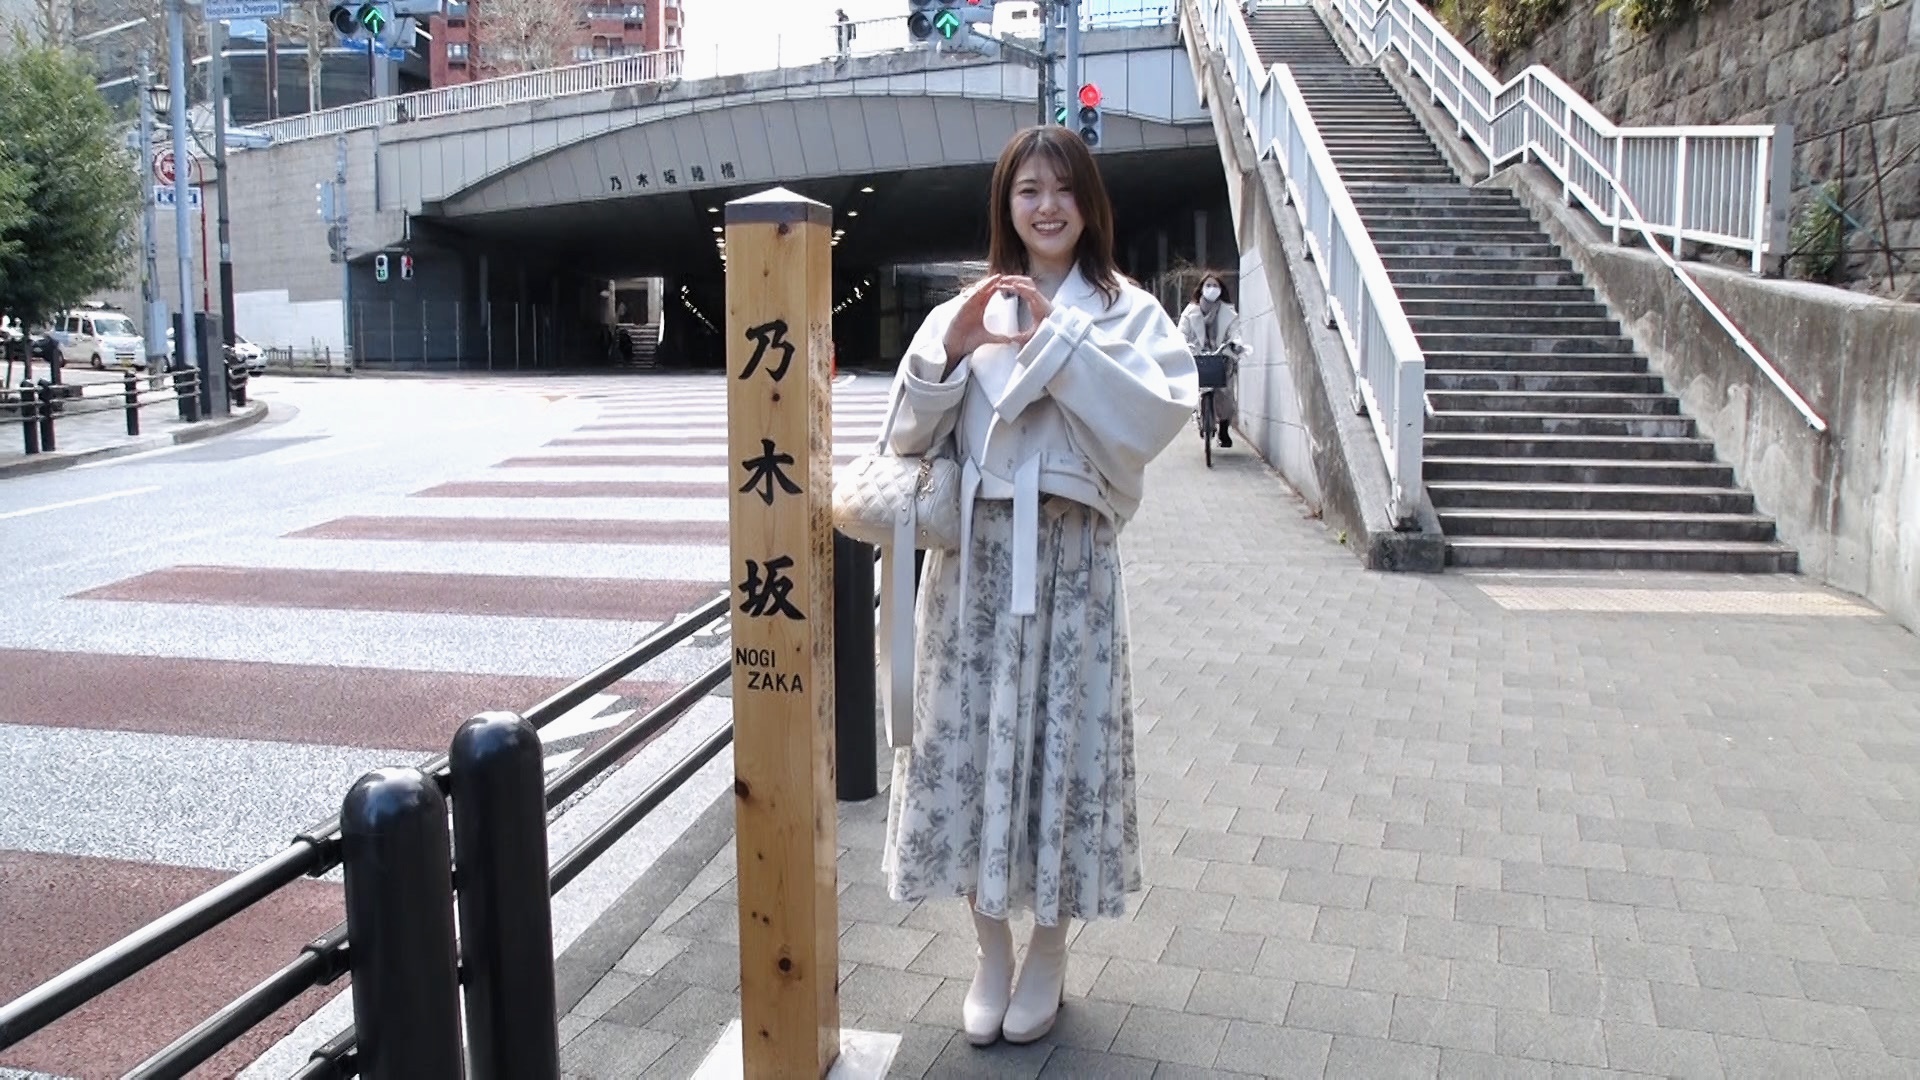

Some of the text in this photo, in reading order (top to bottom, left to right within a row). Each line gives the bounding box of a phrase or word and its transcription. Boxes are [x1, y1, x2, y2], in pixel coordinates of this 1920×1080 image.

[609, 161, 736, 192] 乃木坂陸橋
[738, 319, 806, 621] 乃木坂
[735, 647, 776, 668] NOGI
[747, 671, 803, 694] ZAKA
